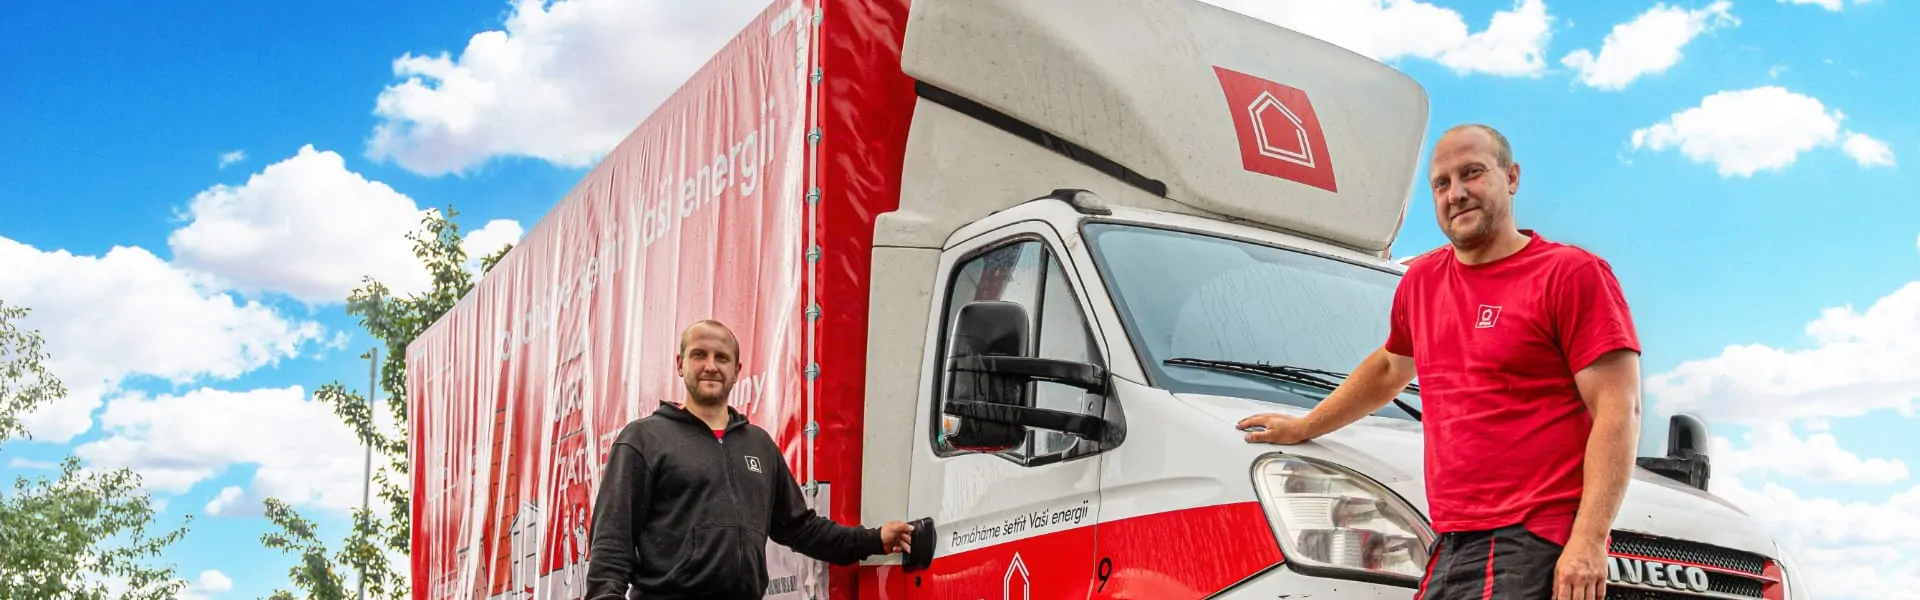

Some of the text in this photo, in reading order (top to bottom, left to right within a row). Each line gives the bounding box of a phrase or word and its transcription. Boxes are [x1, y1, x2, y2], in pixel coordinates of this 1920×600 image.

[681, 96, 776, 218] energii
[951, 500, 1089, 547] Pomáháme šetřit Vaši energii
[1097, 556, 1112, 593] 9
[1607, 557, 1709, 592] IVECO
